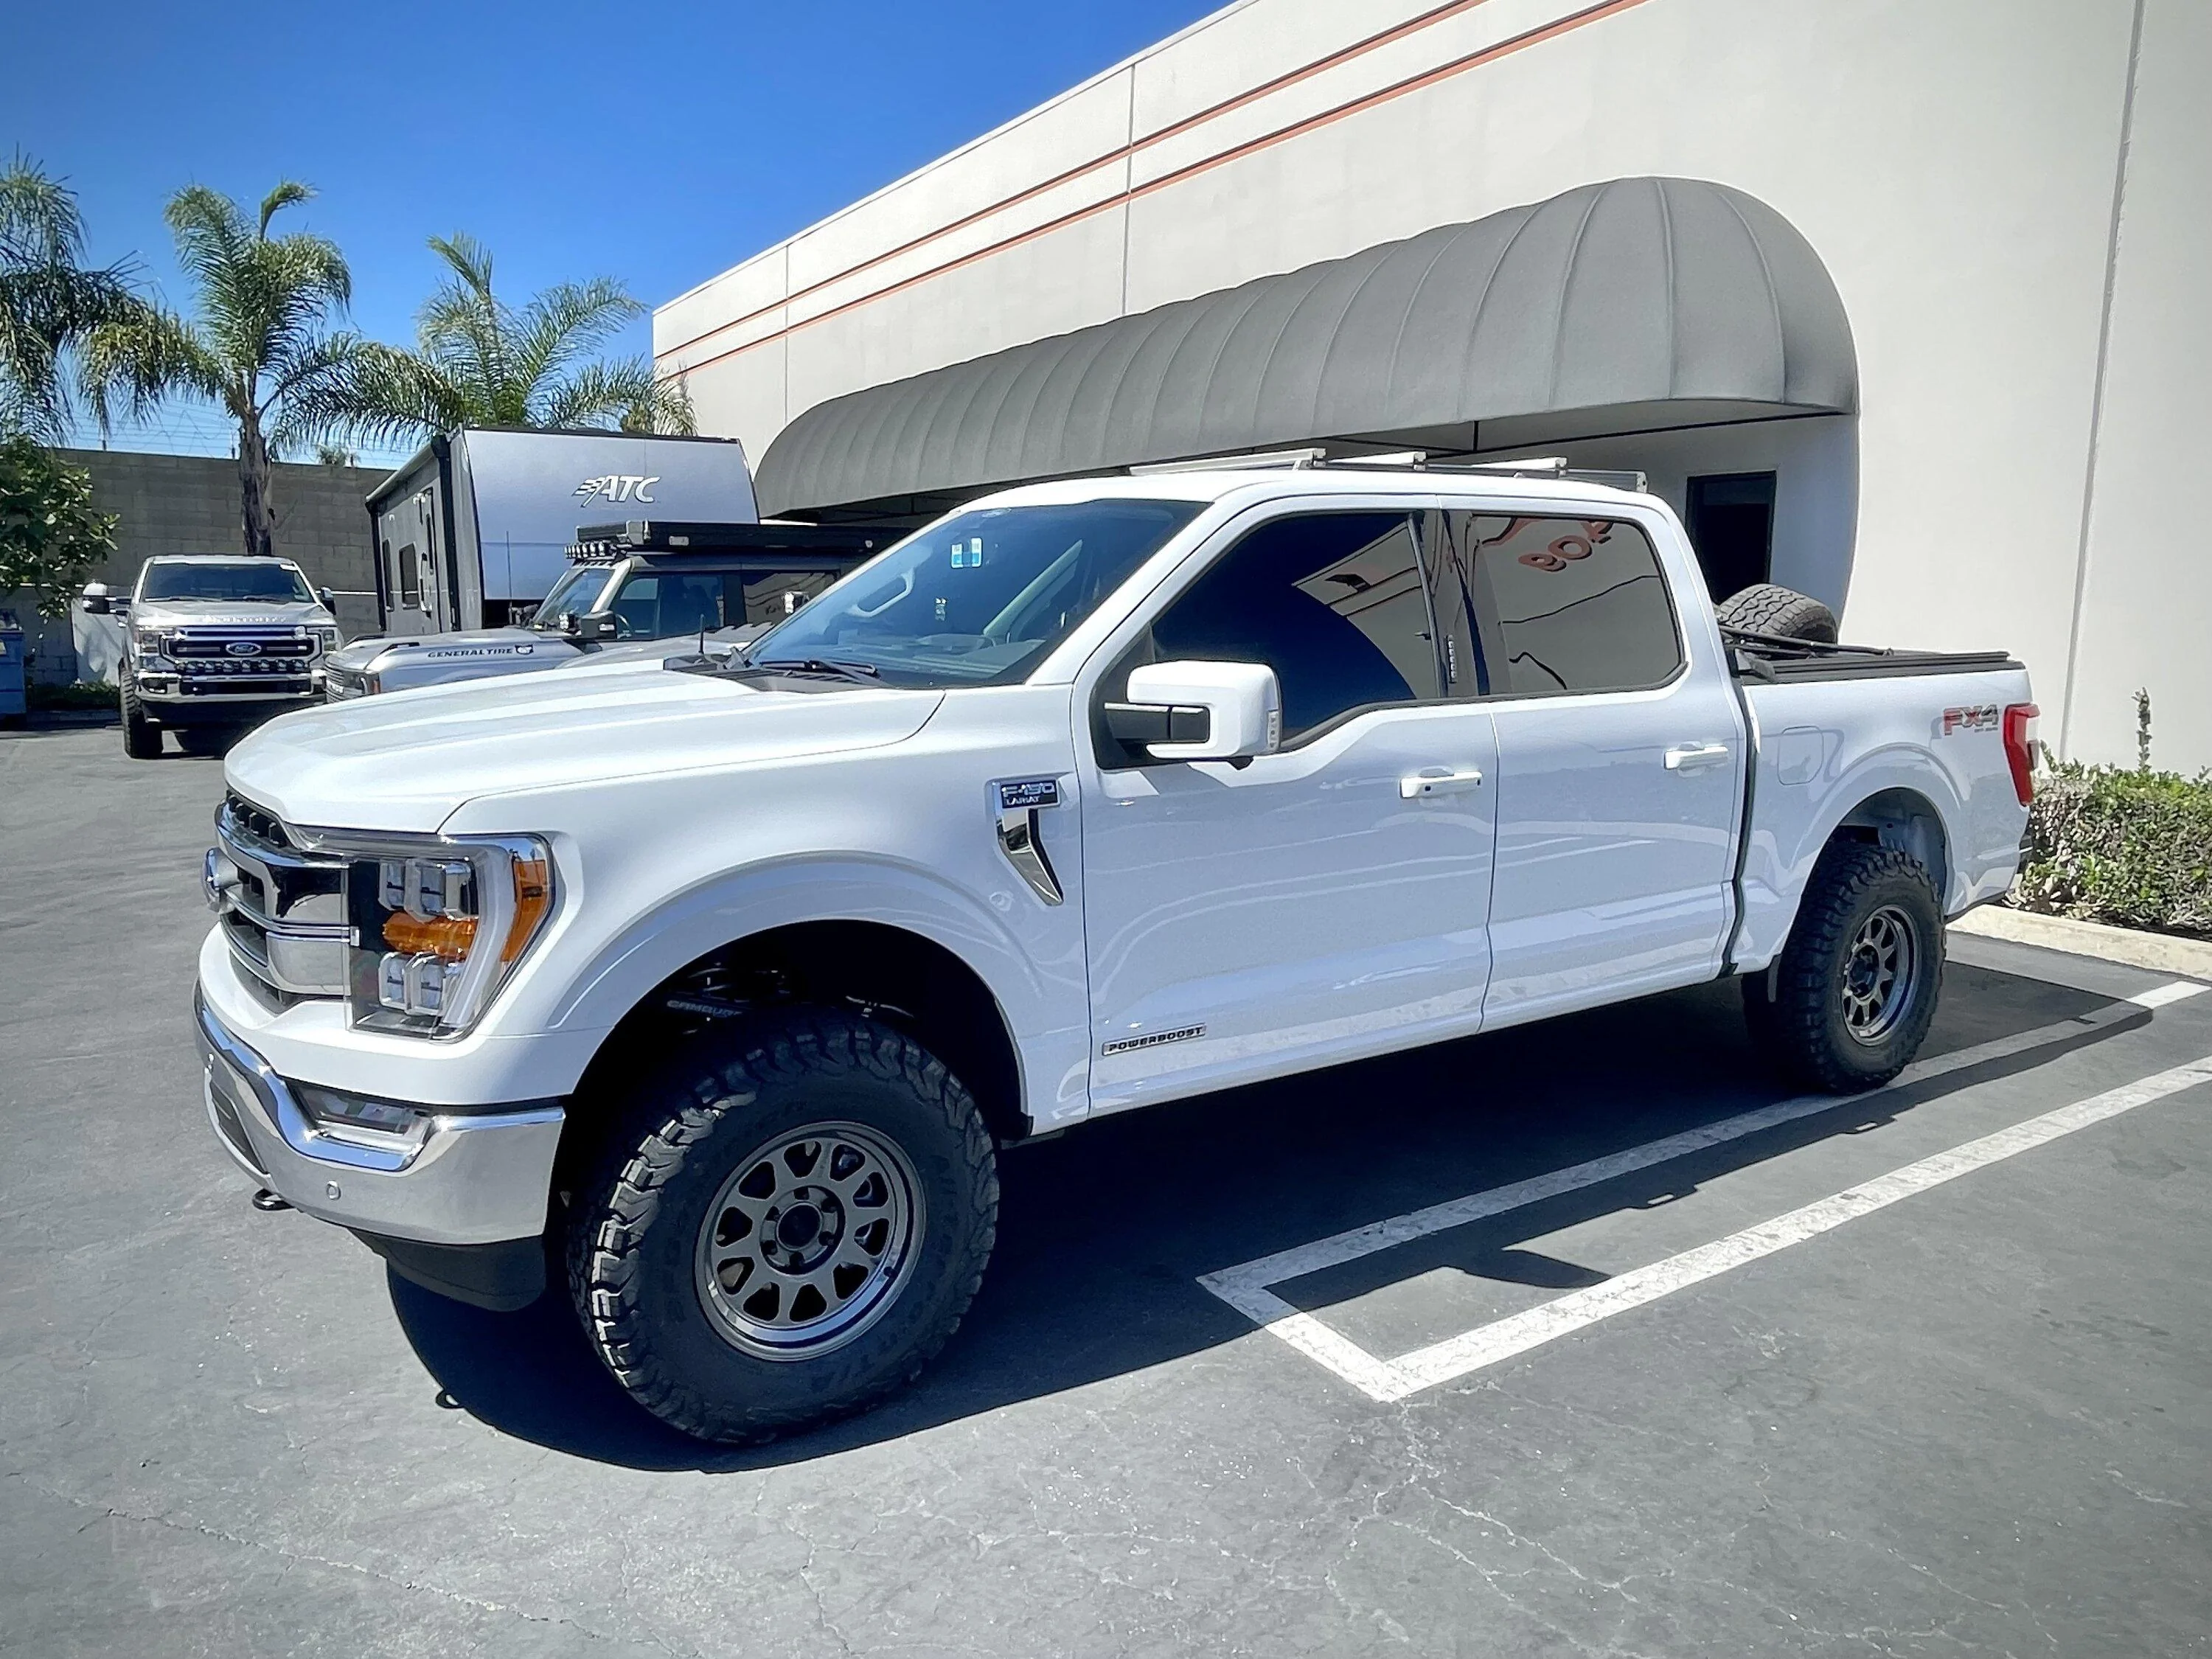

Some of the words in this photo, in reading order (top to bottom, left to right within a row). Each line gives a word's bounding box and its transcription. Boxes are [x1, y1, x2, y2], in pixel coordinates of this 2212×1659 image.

[582, 475, 661, 507] ATC
[428, 650, 484, 658] GENERAL
[1943, 704, 1999, 736] FX4
[1001, 782, 1055, 797] F-150
[1006, 796, 1040, 806] LARIAT
[1108, 1026, 1203, 1051] POWERBOOST
